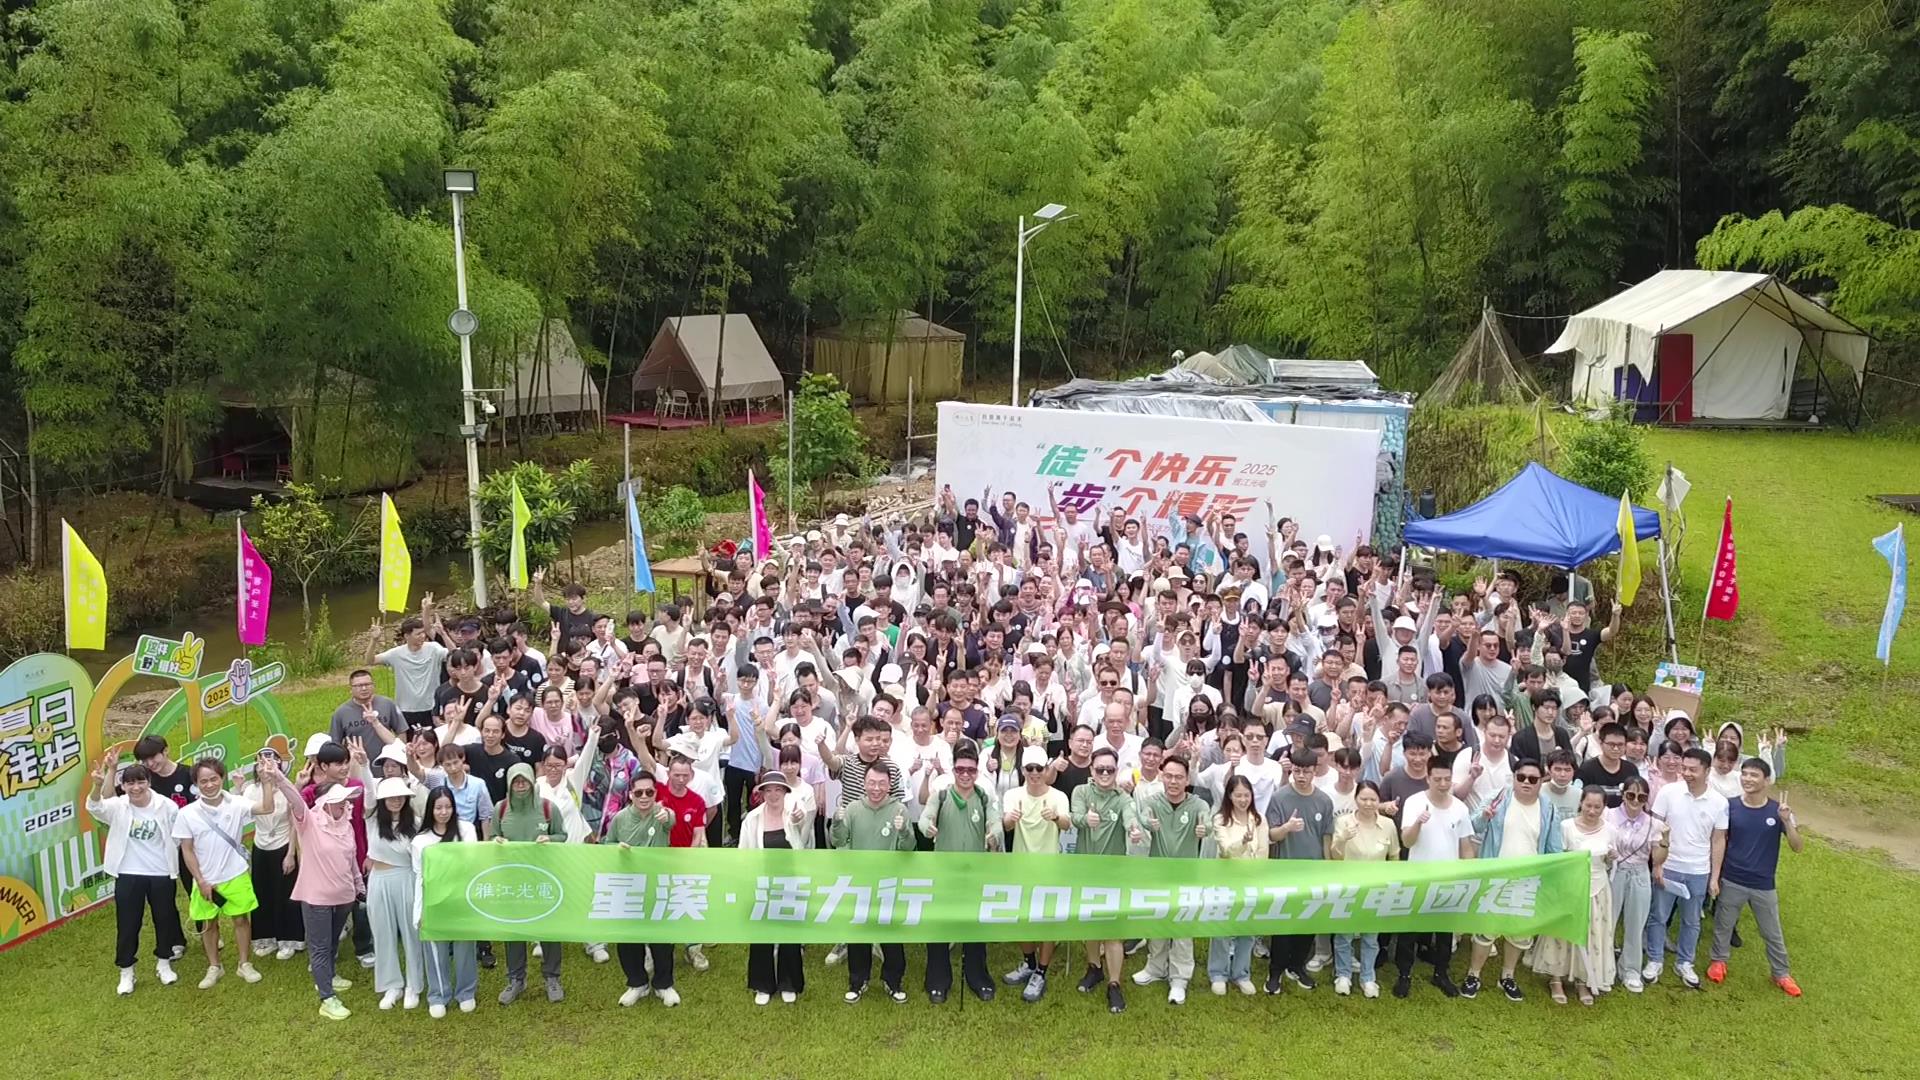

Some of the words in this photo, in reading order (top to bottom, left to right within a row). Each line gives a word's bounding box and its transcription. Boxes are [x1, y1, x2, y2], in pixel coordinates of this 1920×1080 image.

[1035, 443, 1237, 487] “徒”个快乐
[1239, 463, 1278, 476] 2025
[0, 687, 76, 746] 夏日
[206, 687, 230, 705] 2025
[0, 733, 81, 801] 徒步
[25, 803, 73, 833] 2025
[474, 882, 555, 900] 雅江光電
[588, 872, 934, 925] 星溪·活力行
[978, 875, 1542, 924] 2025雅江光电团建
